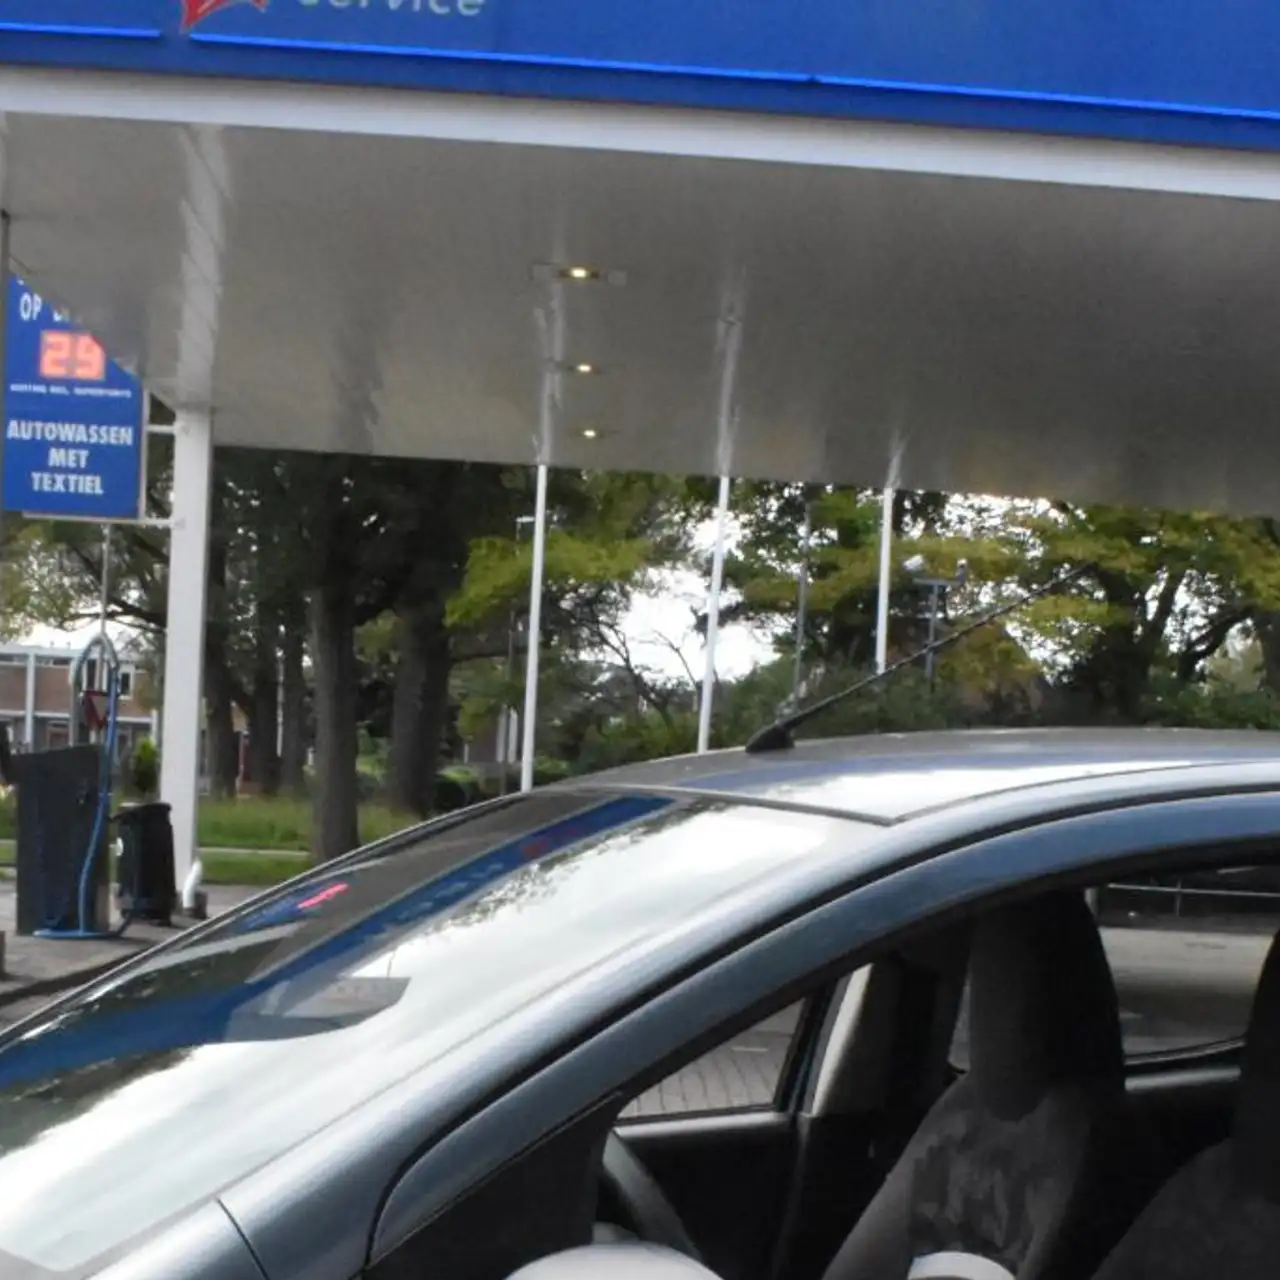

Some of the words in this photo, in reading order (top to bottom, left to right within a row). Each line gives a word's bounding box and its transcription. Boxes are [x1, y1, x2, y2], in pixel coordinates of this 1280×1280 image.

[20, 292, 42, 320] OP
[7, 420, 133, 446] AUTOWASSEN
[48, 448, 89, 468] MET
[31, 472, 103, 495] TEXTIEL
